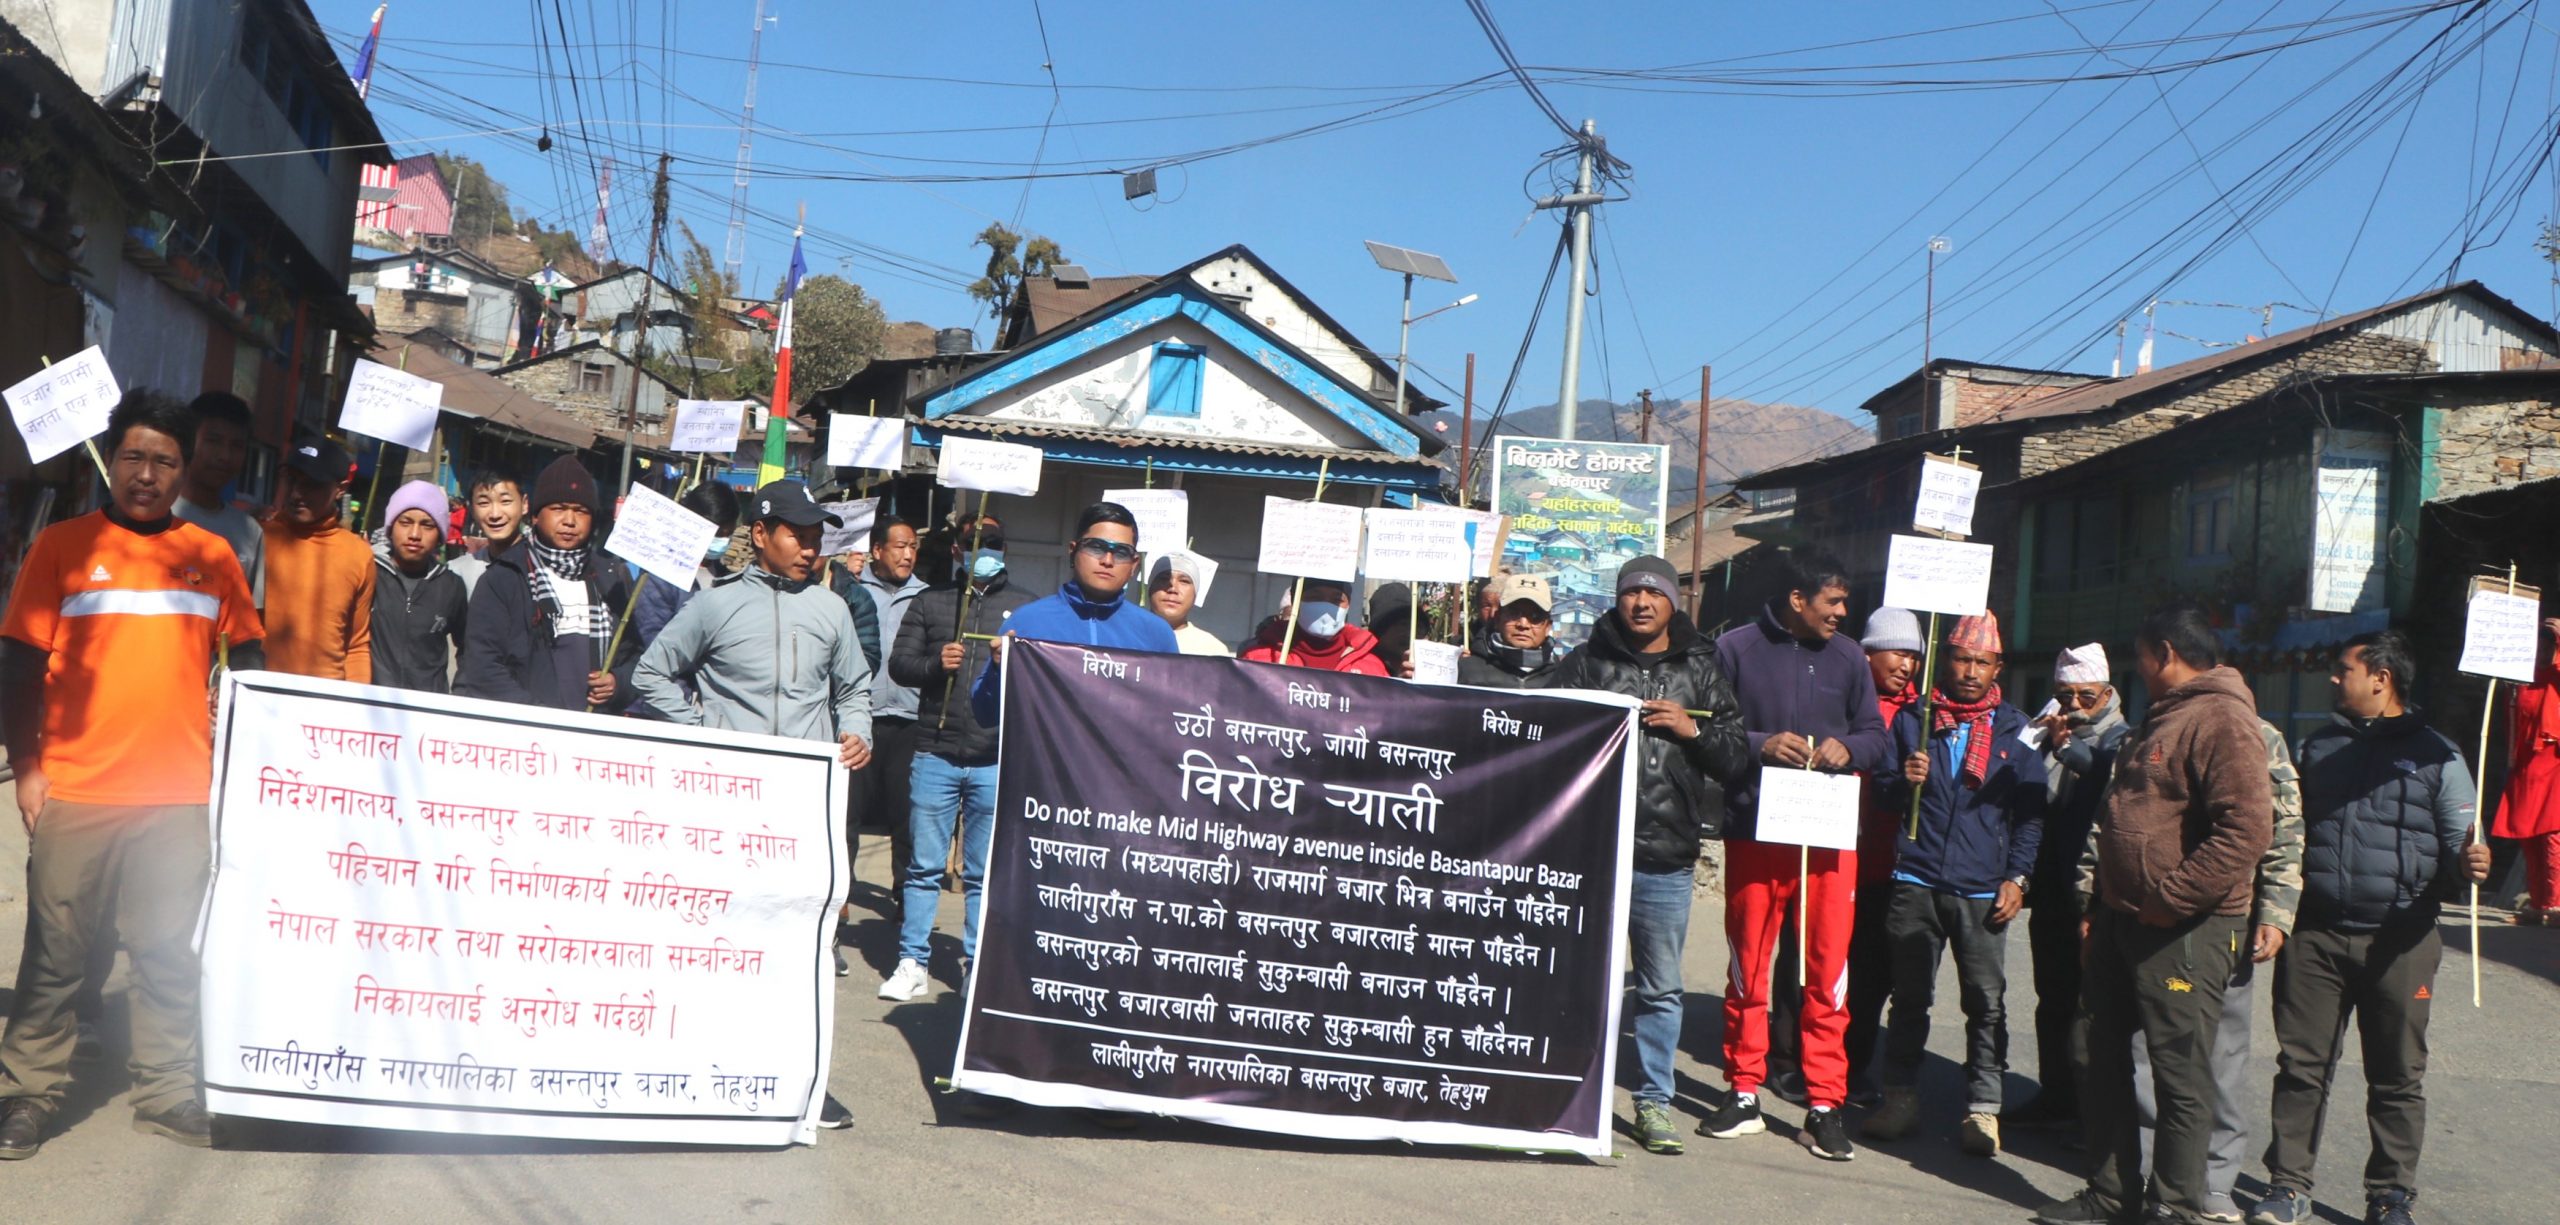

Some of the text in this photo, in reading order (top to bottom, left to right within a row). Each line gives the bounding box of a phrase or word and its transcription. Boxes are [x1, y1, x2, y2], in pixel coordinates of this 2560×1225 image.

[1083, 653, 1129, 680] विरोध
[1288, 681, 1333, 709] विरोध
[1224, 718, 1312, 759] बसन्तपुर,
[1378, 741, 1457, 781] बसन्तपुर
[1482, 707, 1523, 737] विरोध
[301, 724, 403, 761] पुष्पलाल
[573, 755, 656, 789] राजमार्ग
[672, 760, 763, 801] आयोजना
[1178, 749, 1306, 816] विरोध
[417, 800, 520, 847] बसन्तपुर
[738, 824, 798, 868] भूगोल
[1025, 797, 1584, 890] Do not make Mid Highway avenue inside Basantapur Bazar
[327, 842, 422, 888] पहिचान
[434, 854, 477, 893] गरि
[623, 872, 734, 927] गरिदिनुहुन
[1029, 837, 1111, 870] पुष्पलाल
[1251, 865, 1329, 897] राजमार्ग
[1336, 877, 1389, 906] बजार
[1396, 874, 1435, 910] भित्र
[268, 898, 765, 976] नेपाल सरकार तथा सरोकारवाला सम्बन्धित
[1037, 883, 1139, 924] लालीगुराँस
[1236, 911, 1323, 949] बसन्तपुर
[1330, 921, 1420, 956] बजारलाई
[1427, 934, 1476, 960] मास्न
[1035, 930, 1143, 972] बसन्तपुरको
[1151, 948, 1249, 983] जनतालाई
[1257, 960, 1353, 994] सुकुम्बासी
[1360, 972, 1429, 1000] बनाउन
[354, 974, 487, 1026] निकायलाई
[503, 988, 582, 1039] अनुरोध
[1031, 978, 1111, 1018] बसन्तपुर
[1118, 991, 1219, 1024] बजारबासी
[1227, 1004, 1315, 1037] जनताहरु
[1323, 1014, 1417, 1048] सुकुम्बासी
[1423, 1024, 1454, 1058] हुन
[240, 1040, 368, 1090] लालीगुराँस
[380, 1053, 519, 1093] नगरपालिका
[530, 1069, 623, 1109] बसन्तपुर
[1091, 1040, 1180, 1079] लालीगुराँस
[1187, 1052, 1293, 1087] नगरपालिका
[1300, 1068, 1376, 1103] बसन्तपुर
[1382, 1076, 1429, 1104] बजार,
